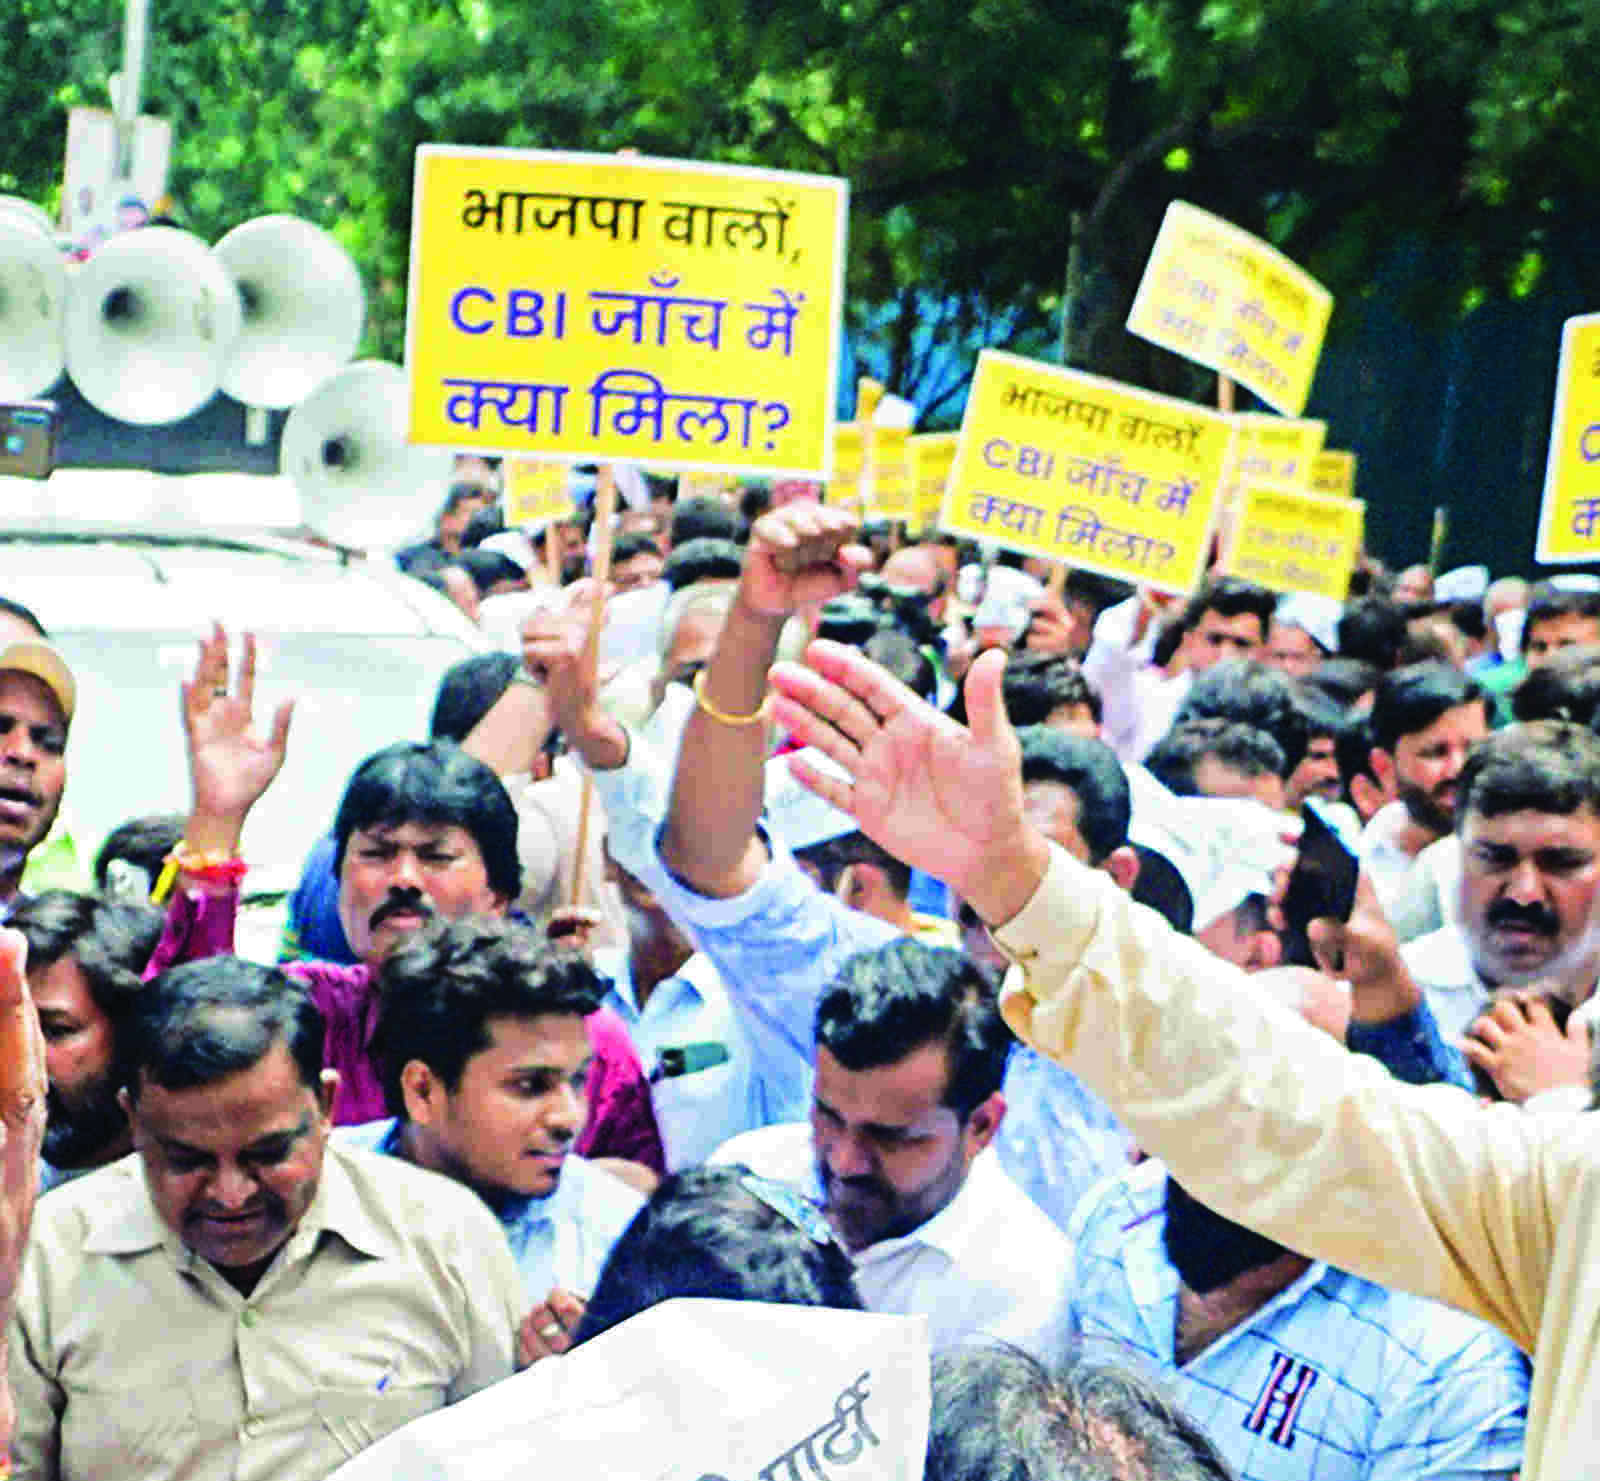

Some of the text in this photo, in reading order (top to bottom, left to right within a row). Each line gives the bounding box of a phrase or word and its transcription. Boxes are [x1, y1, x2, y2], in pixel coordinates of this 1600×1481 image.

[462, 190, 802, 263] भाजपा वालों,
[450, 270, 806, 356] CBI जाँच में
[442, 369, 791, 451] क्या मिला?
[1002, 383, 1111, 432] भाजपा
[984, 437, 1054, 480] CBI
[1156, 472, 1200, 518] में
[969, 491, 1175, 569] क्या मिला?
